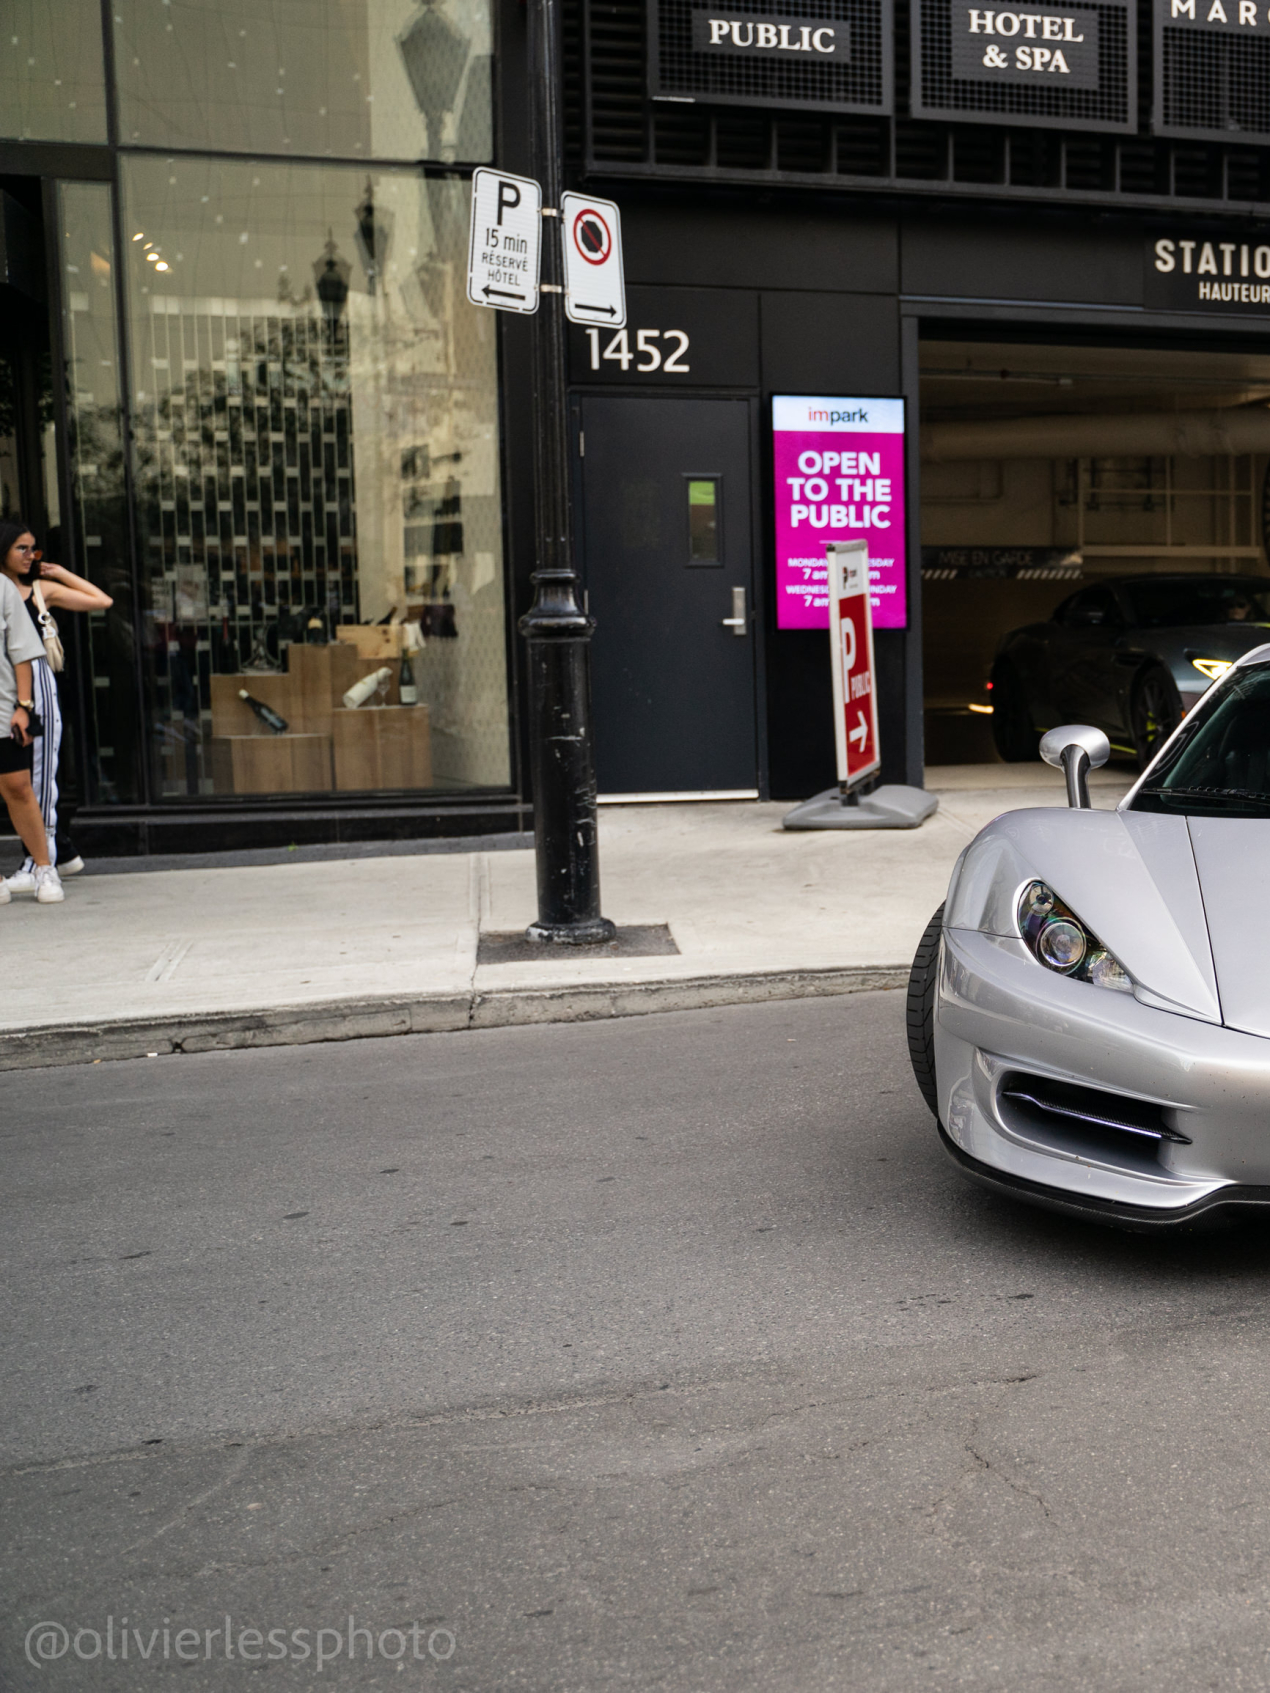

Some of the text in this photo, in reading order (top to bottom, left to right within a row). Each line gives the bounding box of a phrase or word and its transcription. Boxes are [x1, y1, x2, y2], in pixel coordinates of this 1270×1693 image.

[708, 19, 835, 53] PUBLIC
[968, 8, 1084, 43] HOTEL
[982, 44, 1070, 74] & SPA
[497, 180, 521, 226] P
[485, 228, 528, 254] 15 min
[481, 251, 529, 272] RÉSERVÉ
[487, 269, 521, 287] HÔTEL
[1199, 281, 1270, 305] HAUTEUR
[585, 328, 690, 373] 1452
[808, 407, 868, 425] impark
[798, 450, 880, 475] OPEN
[786, 477, 892, 502] TO THE
[790, 504, 891, 529] PUBLIC
[802, 568, 812, 580] 7
[785, 585, 830, 595] WEDNES
[803, 595, 813, 607] 7
[841, 617, 856, 704] P
